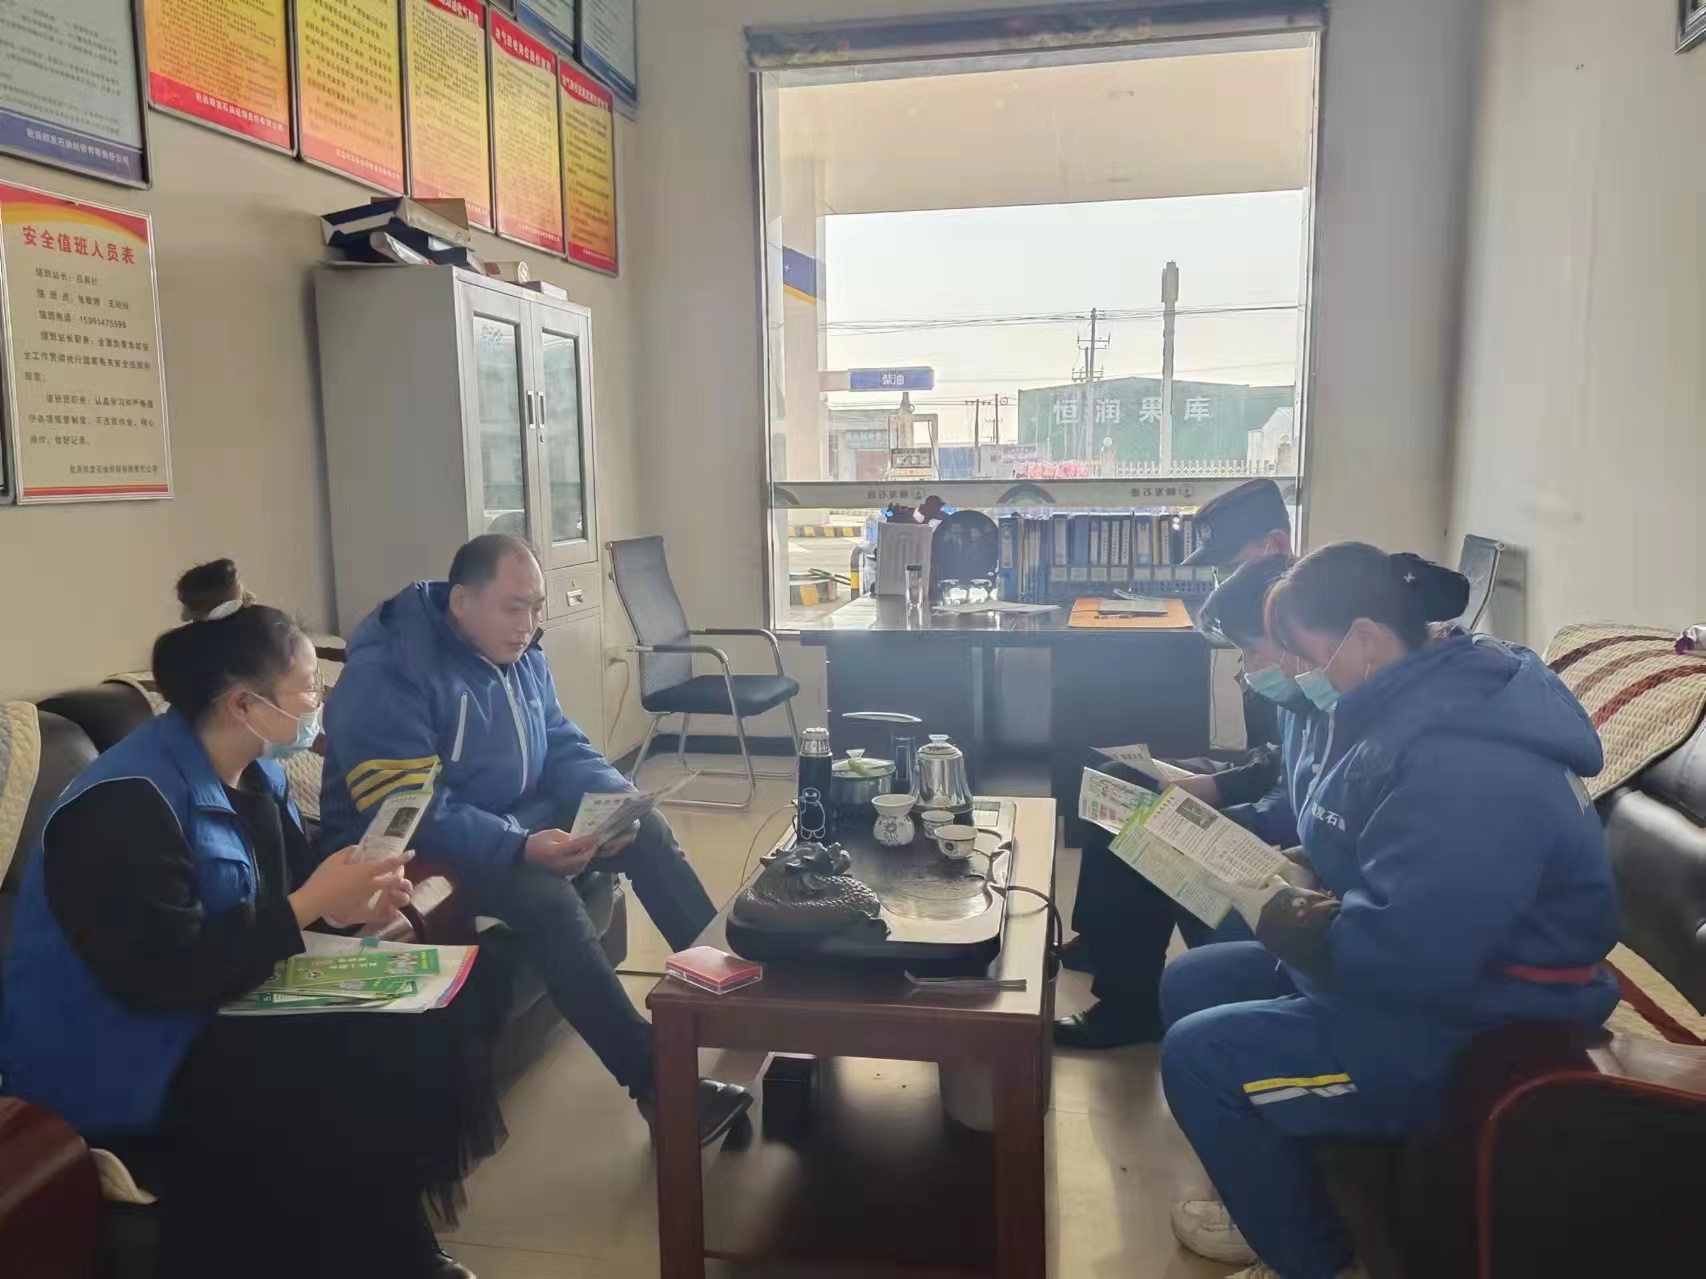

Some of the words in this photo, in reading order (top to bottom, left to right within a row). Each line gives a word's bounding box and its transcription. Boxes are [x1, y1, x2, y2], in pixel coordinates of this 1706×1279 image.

[22, 225, 135, 265] 安全值班人员表
[881, 373, 905, 386] 柴油
[1053, 396, 1212, 425] 恒润果库
